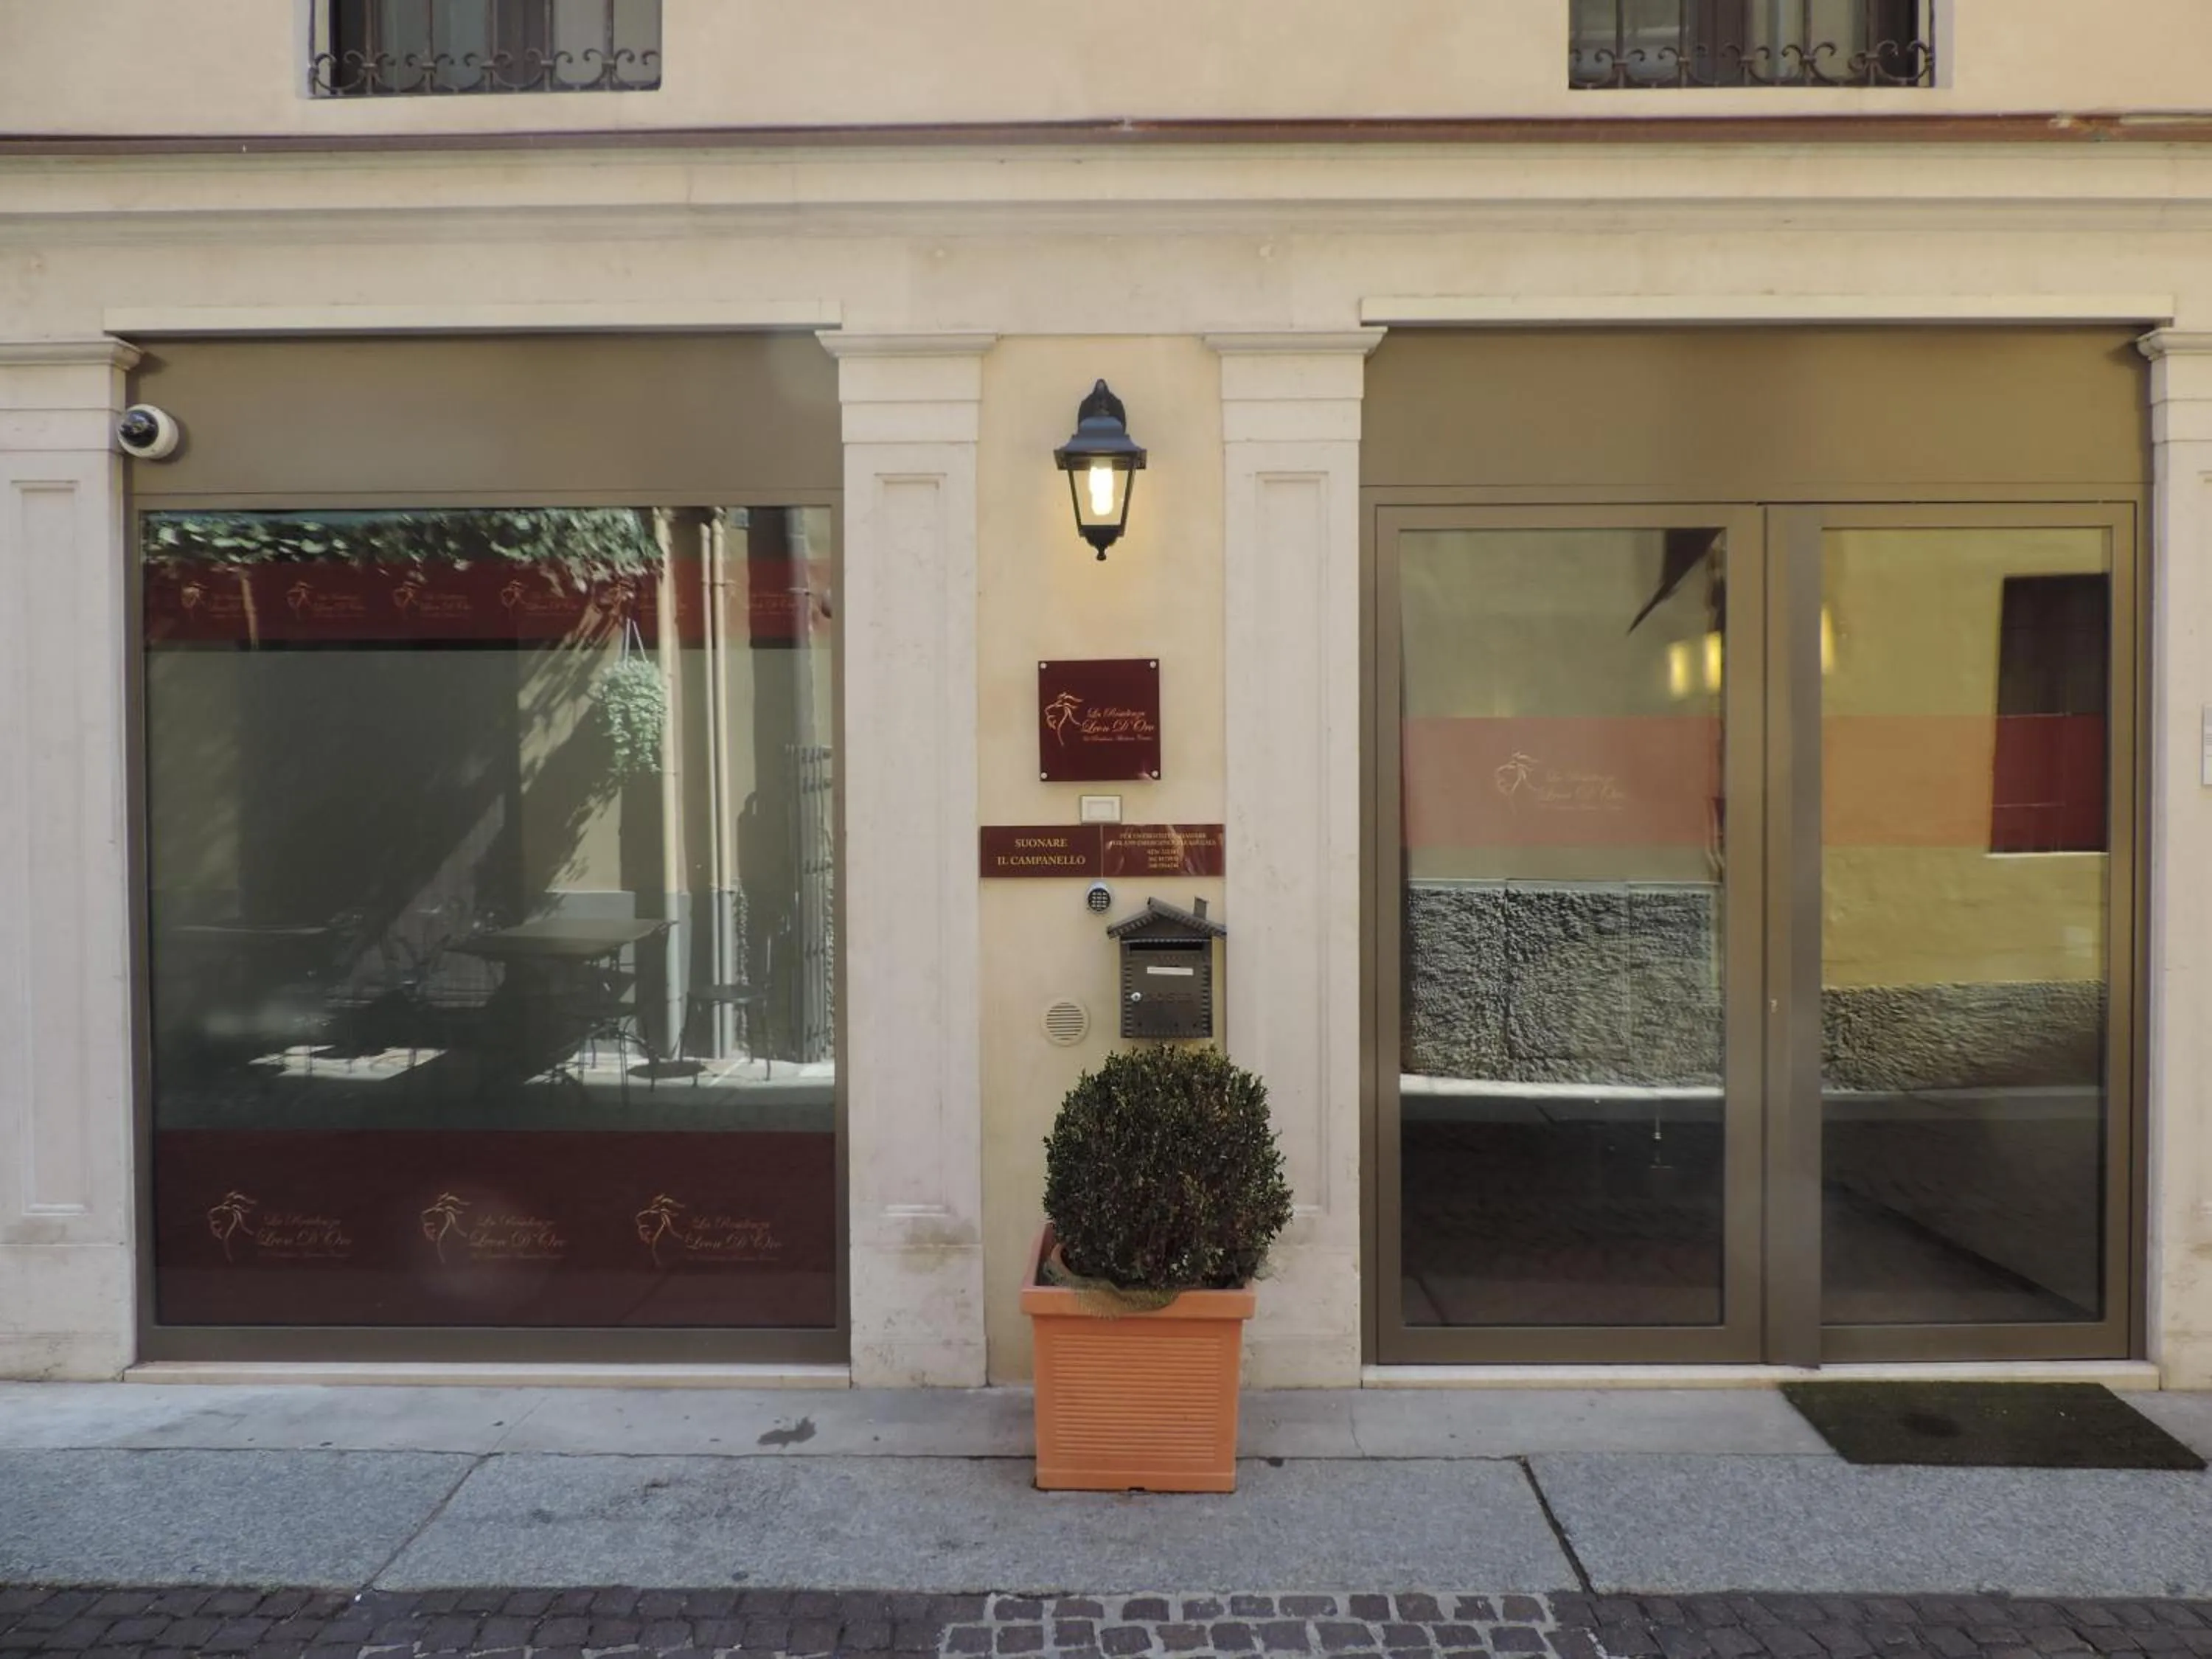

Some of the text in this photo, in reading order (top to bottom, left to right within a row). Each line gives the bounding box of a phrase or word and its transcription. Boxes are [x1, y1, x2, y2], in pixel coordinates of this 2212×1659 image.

[1015, 838, 1068, 848] SUONARE
[998, 855, 1086, 865] IL CAMPANELLO
